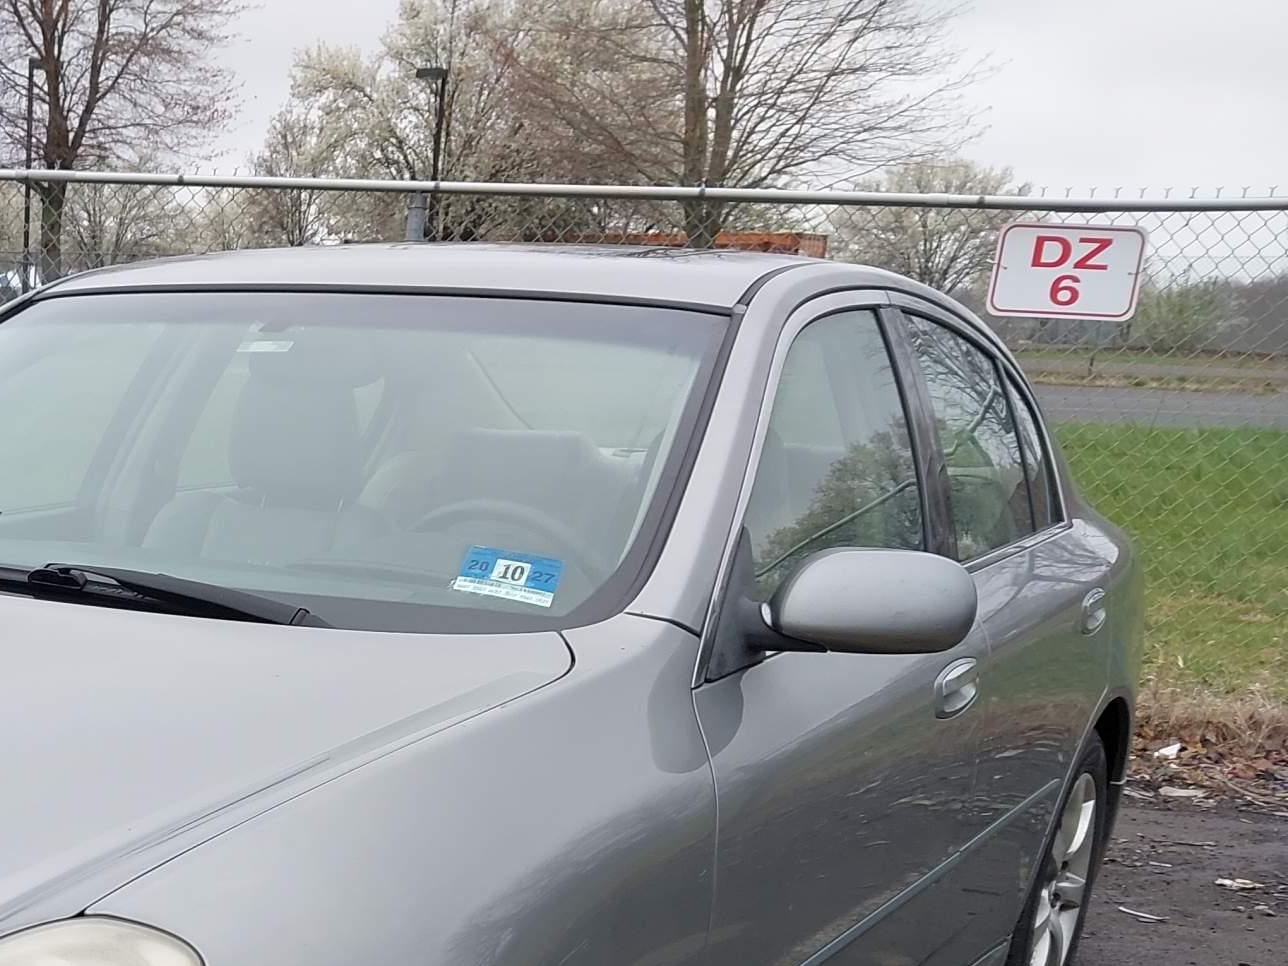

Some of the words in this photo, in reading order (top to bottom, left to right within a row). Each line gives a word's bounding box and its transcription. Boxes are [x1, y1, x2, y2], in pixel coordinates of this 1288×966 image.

[1031, 235, 1113, 271] DZ
[1049, 274, 1081, 307] 6
[467, 559, 489, 572] 20
[498, 563, 525, 582] 10
[533, 570, 556, 584] 27
